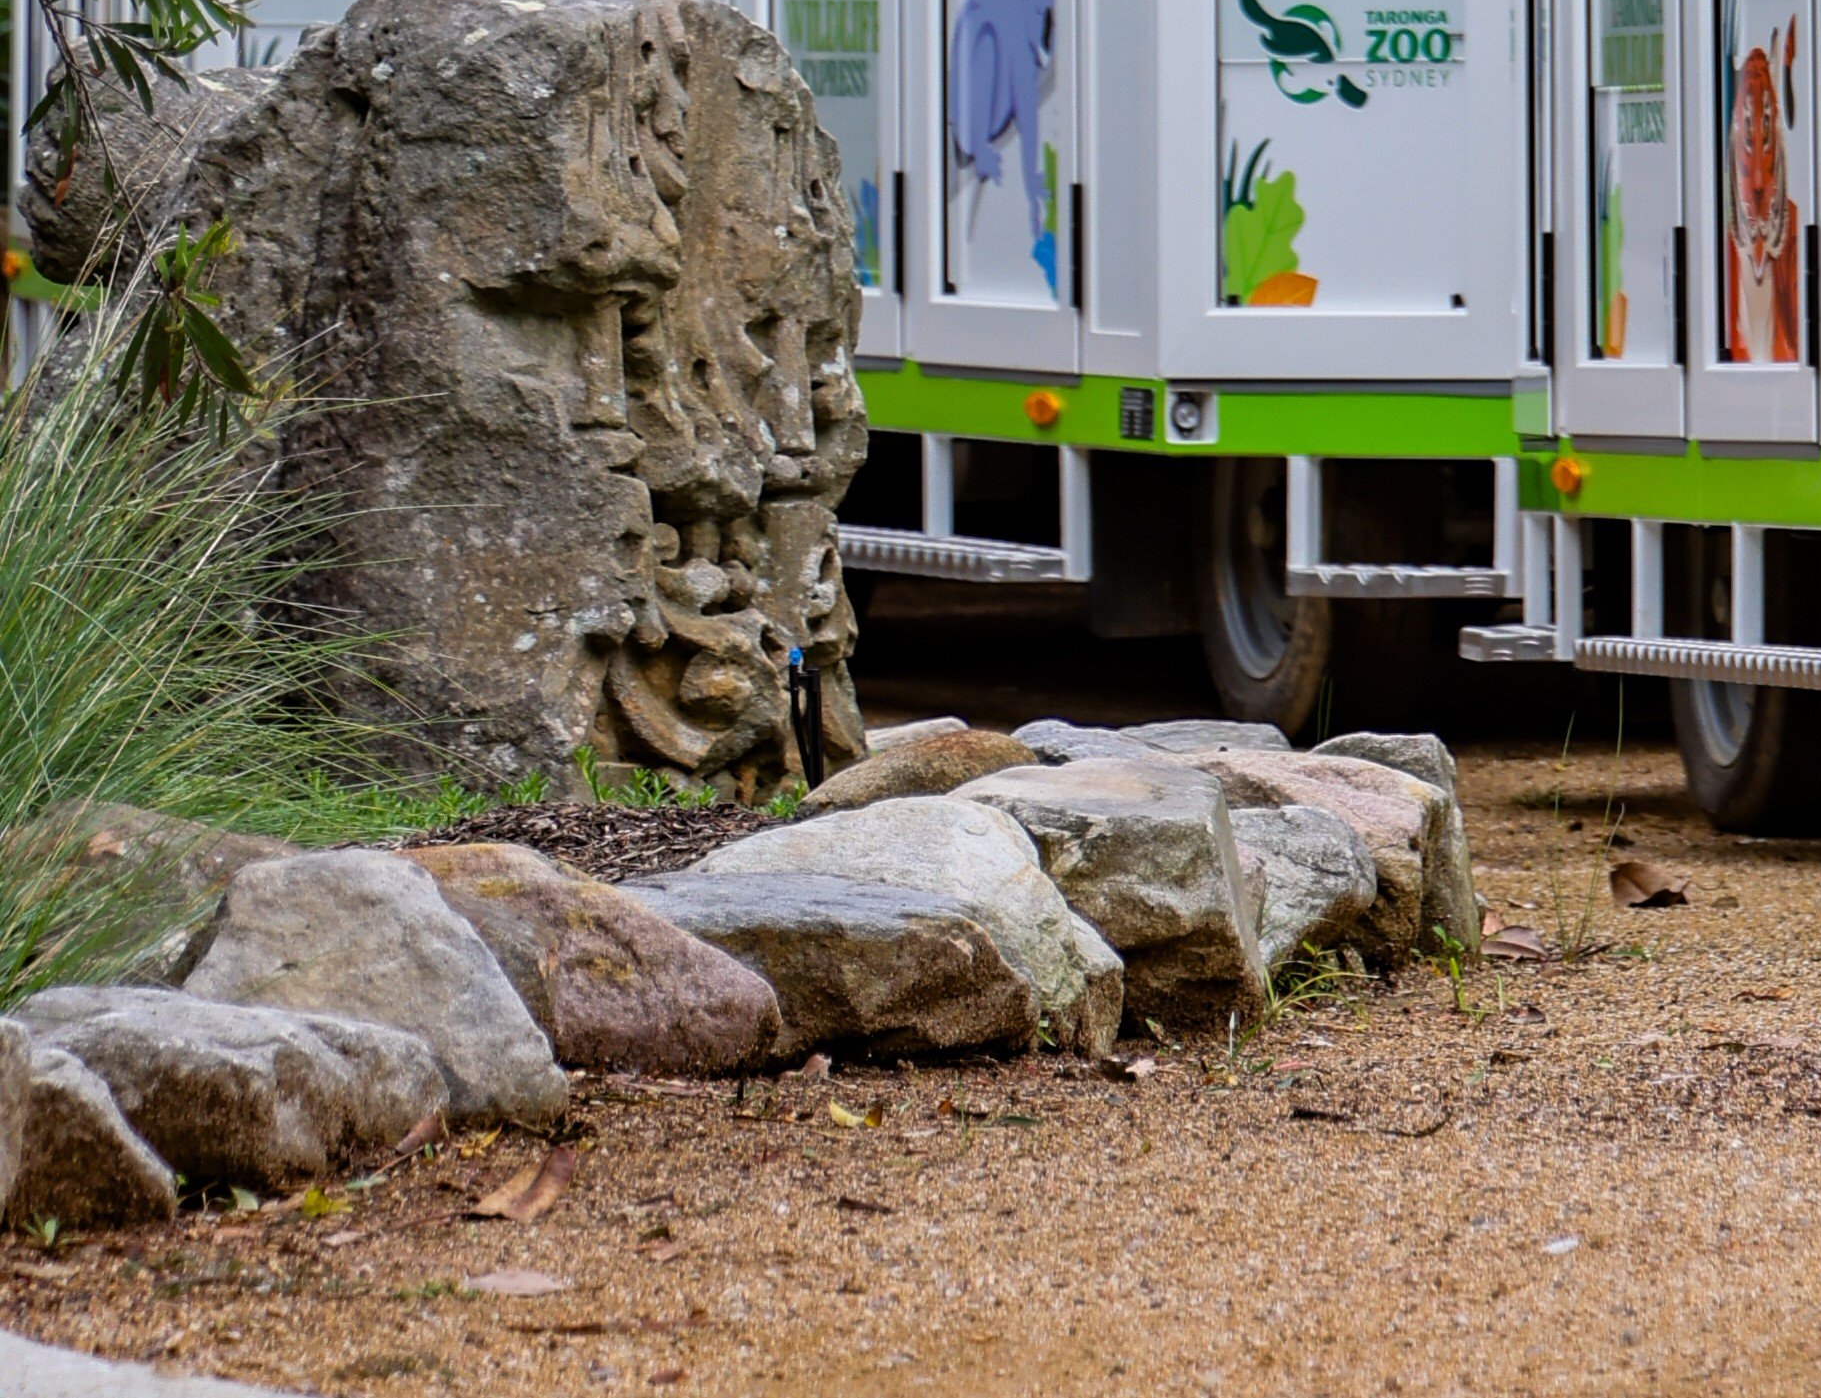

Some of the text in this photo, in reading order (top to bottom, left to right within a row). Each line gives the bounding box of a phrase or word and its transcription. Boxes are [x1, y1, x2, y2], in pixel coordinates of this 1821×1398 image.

[1366, 10, 1448, 24] TARONGA
[1365, 28, 1451, 63] ZOO
[1366, 69, 1450, 87] SYDNEY
